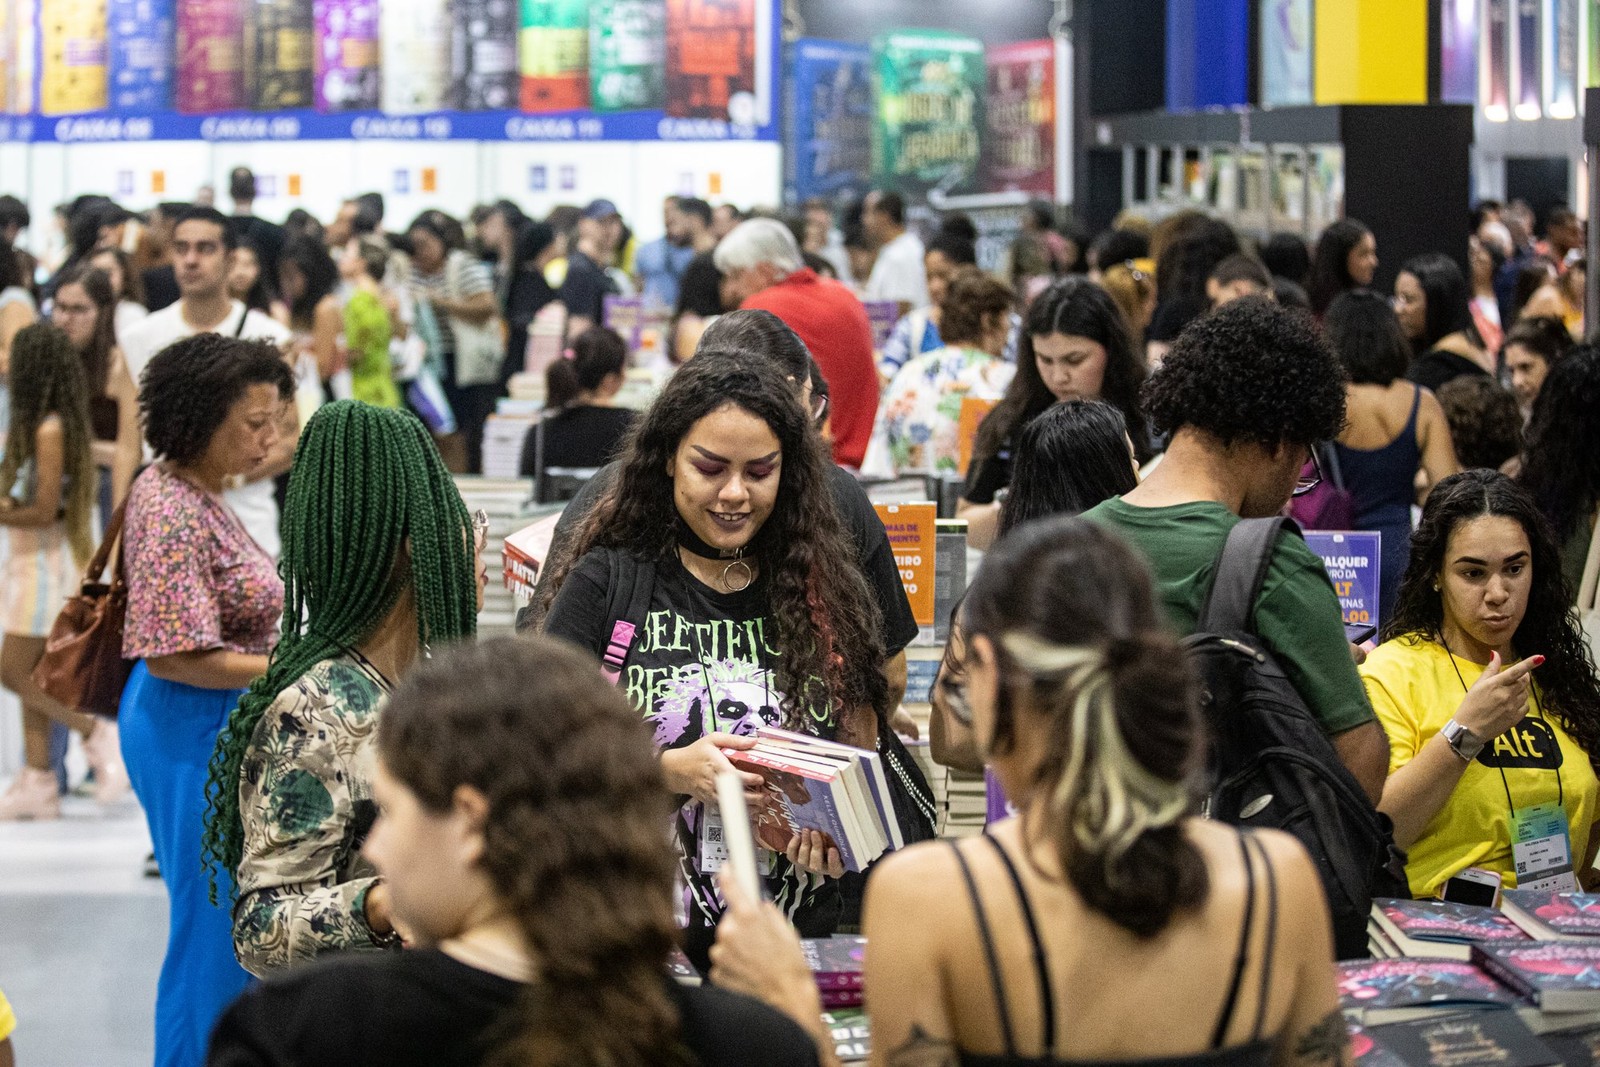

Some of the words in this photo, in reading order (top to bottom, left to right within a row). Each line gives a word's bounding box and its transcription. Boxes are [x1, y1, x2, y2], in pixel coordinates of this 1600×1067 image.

[1345, 569, 1357, 579] DA
[1335, 582, 1353, 596] LT
[1492, 726, 1543, 758] Alt
